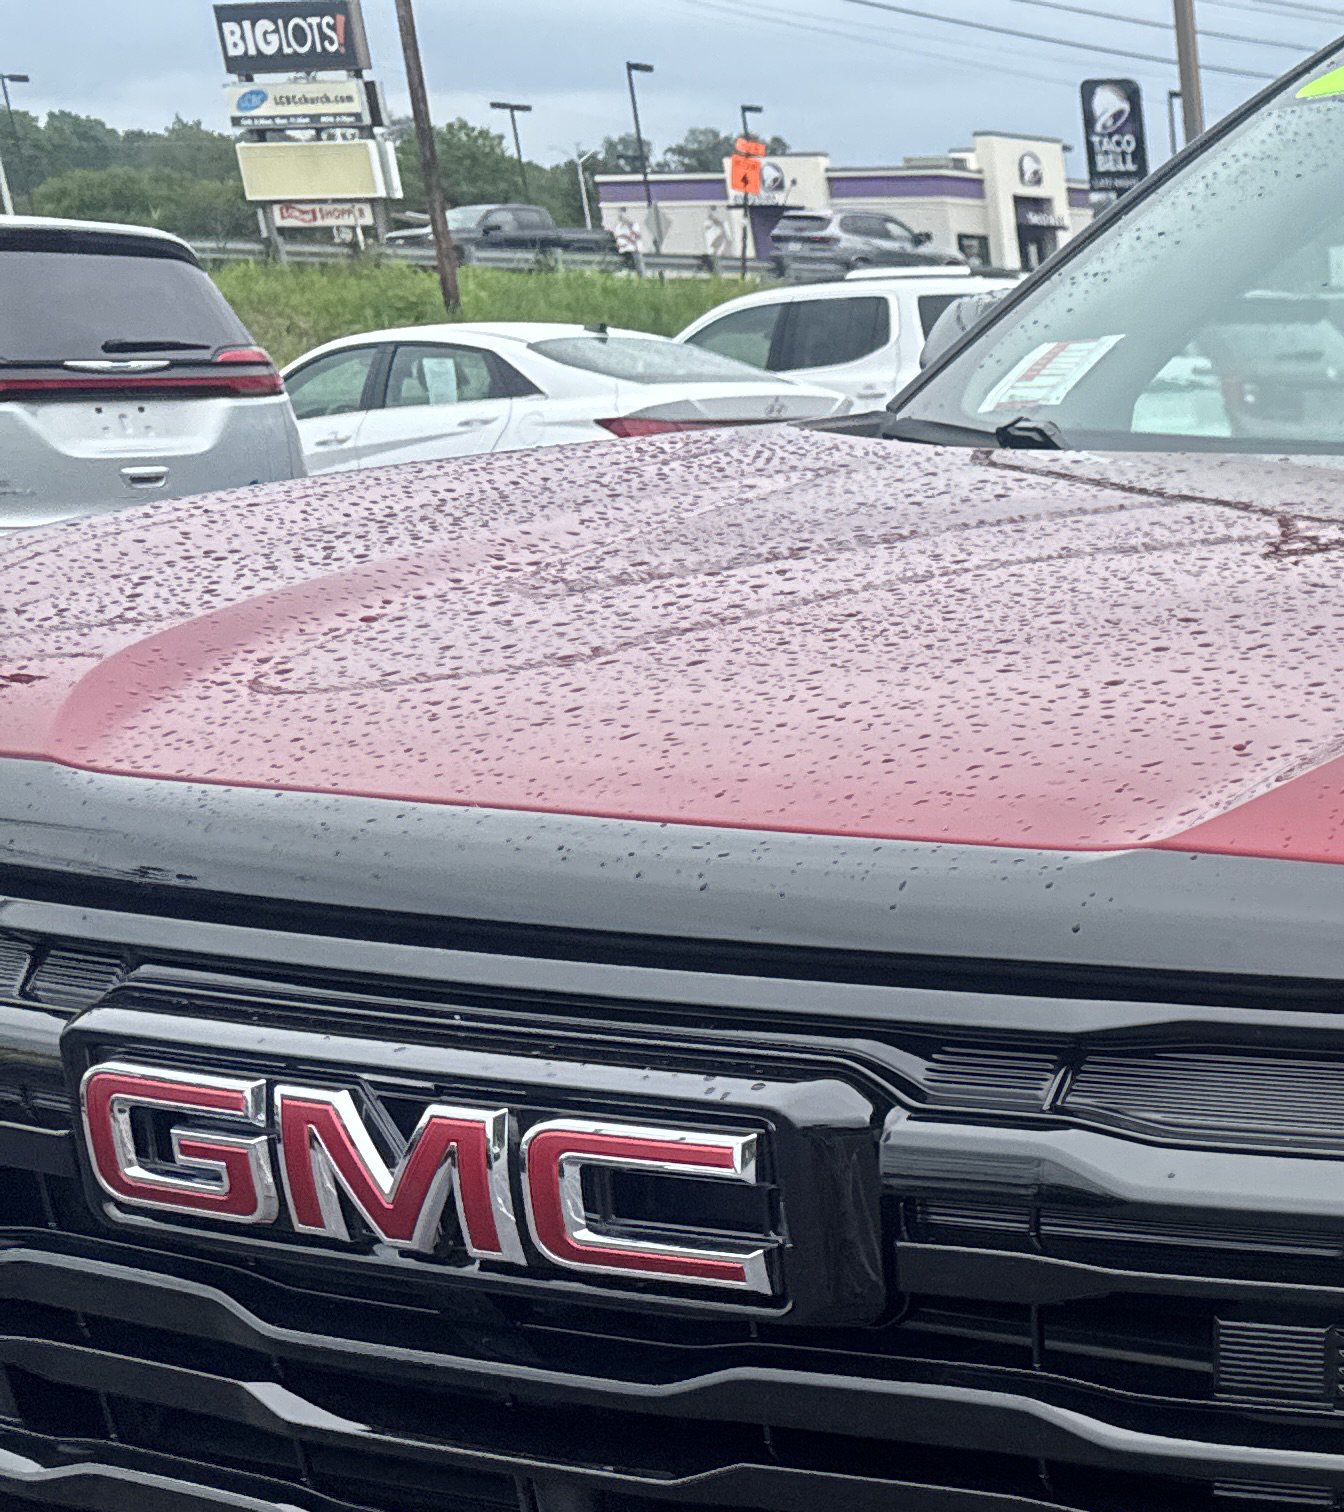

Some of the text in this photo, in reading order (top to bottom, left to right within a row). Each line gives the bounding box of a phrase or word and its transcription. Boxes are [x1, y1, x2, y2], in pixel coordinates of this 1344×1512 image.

[1090, 133, 1136, 154] TACO
[1096, 152, 1138, 172] BELL
[319, 206, 366, 221] SHOPPR
[81, 1061, 773, 1294] GMC
